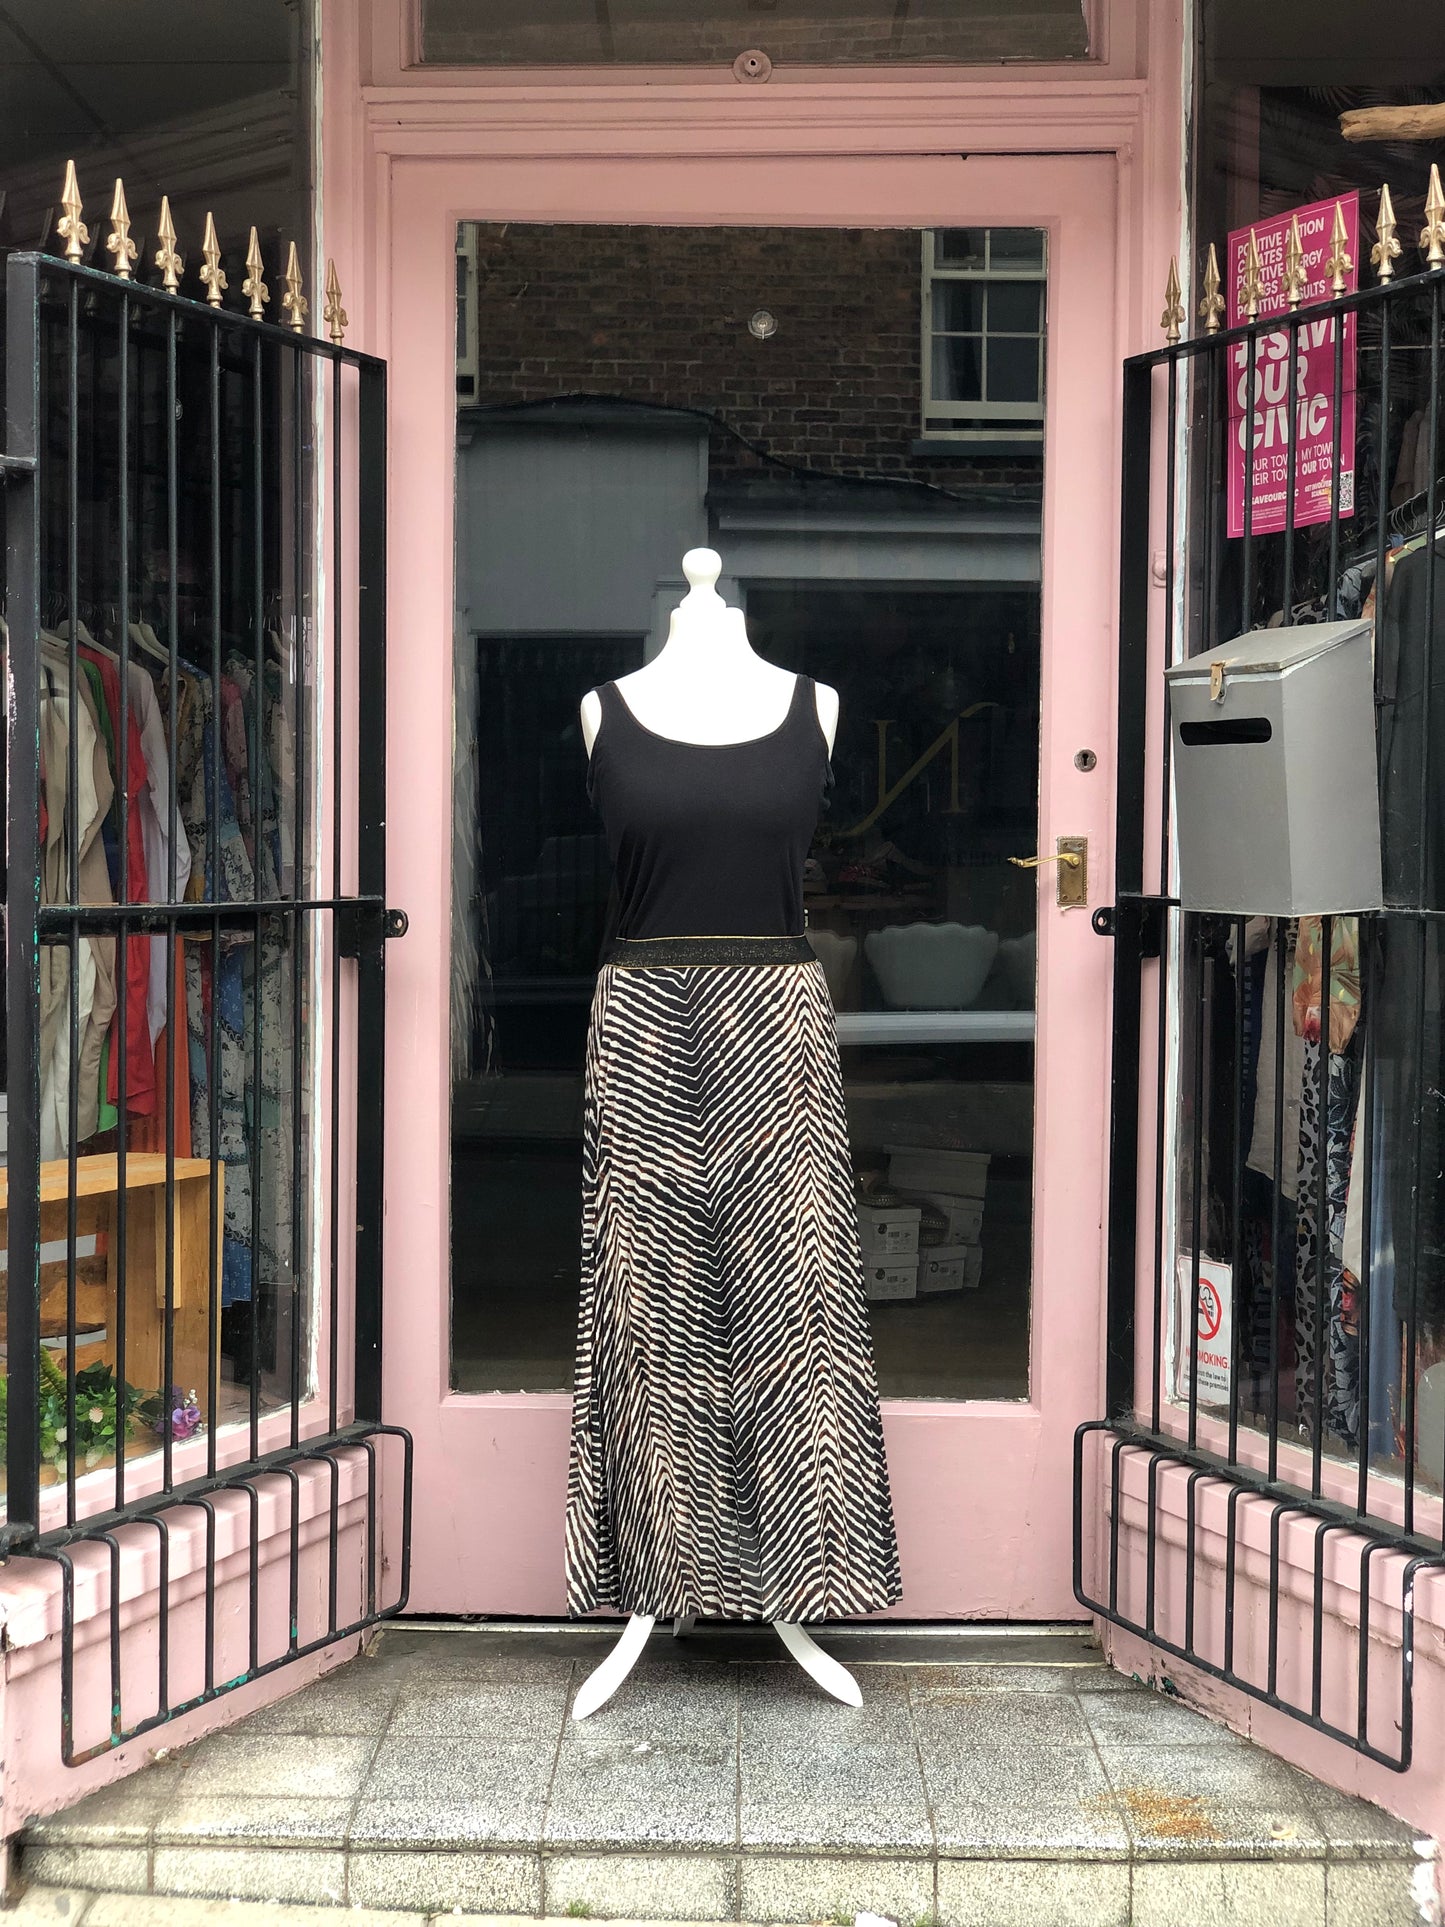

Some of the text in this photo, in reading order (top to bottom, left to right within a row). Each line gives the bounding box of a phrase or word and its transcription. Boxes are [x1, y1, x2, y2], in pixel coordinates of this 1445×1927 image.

[1238, 217, 1324, 260] POITIVE ATION
[1237, 247, 1283, 274] CATES
[1287, 279, 1326, 300] SULTS
[1237, 355, 1309, 410] OUR
[1238, 393, 1328, 452] CIVIC
[1242, 457, 1269, 474] YUR
[1302, 446, 1313, 461] MY
[1302, 460, 1317, 475] OUR
[1197, 1350, 1230, 1369] MOKING.
